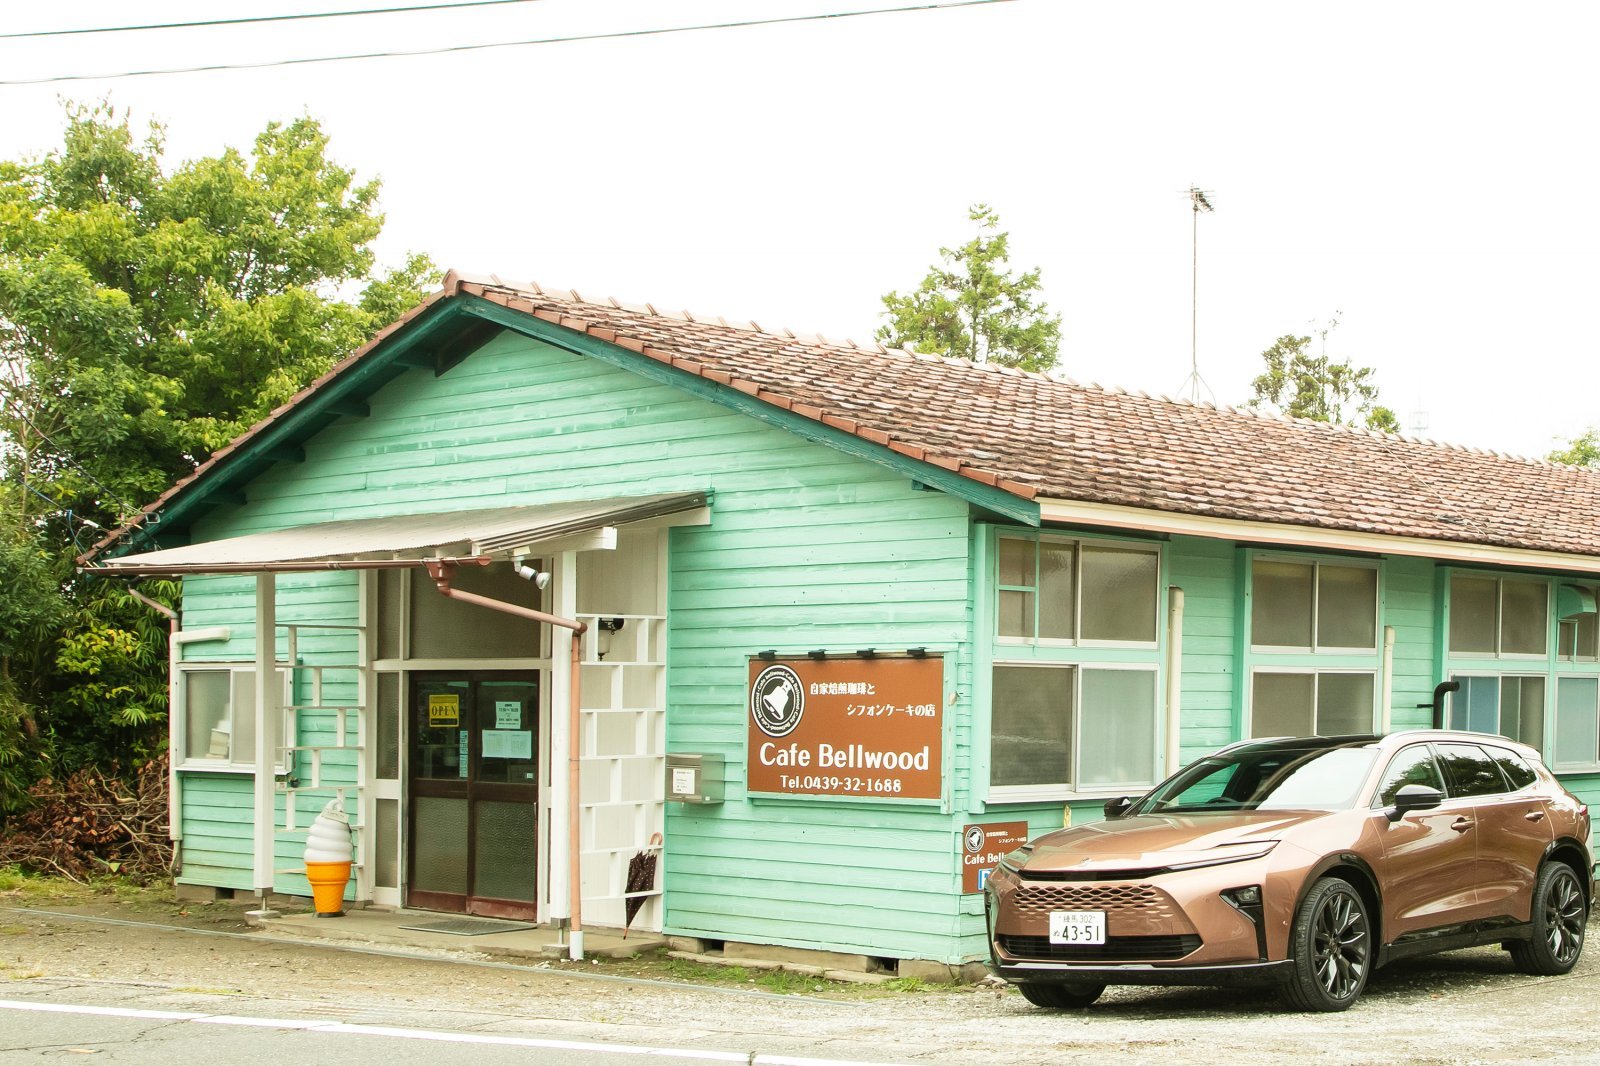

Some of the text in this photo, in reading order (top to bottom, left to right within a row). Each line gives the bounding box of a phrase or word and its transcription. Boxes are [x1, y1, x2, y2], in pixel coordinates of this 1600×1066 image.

[431, 705, 456, 716] OPEN
[847, 704, 936, 717] シフォンケーキの店
[759, 742, 930, 771] Cafe Bellwood
[780, 775, 902, 793] Tel.0439-32-1688
[964, 854, 985, 865] Cafe
[1080, 915, 1093, 924] 302
[1062, 925, 1099, 941] 43-51
